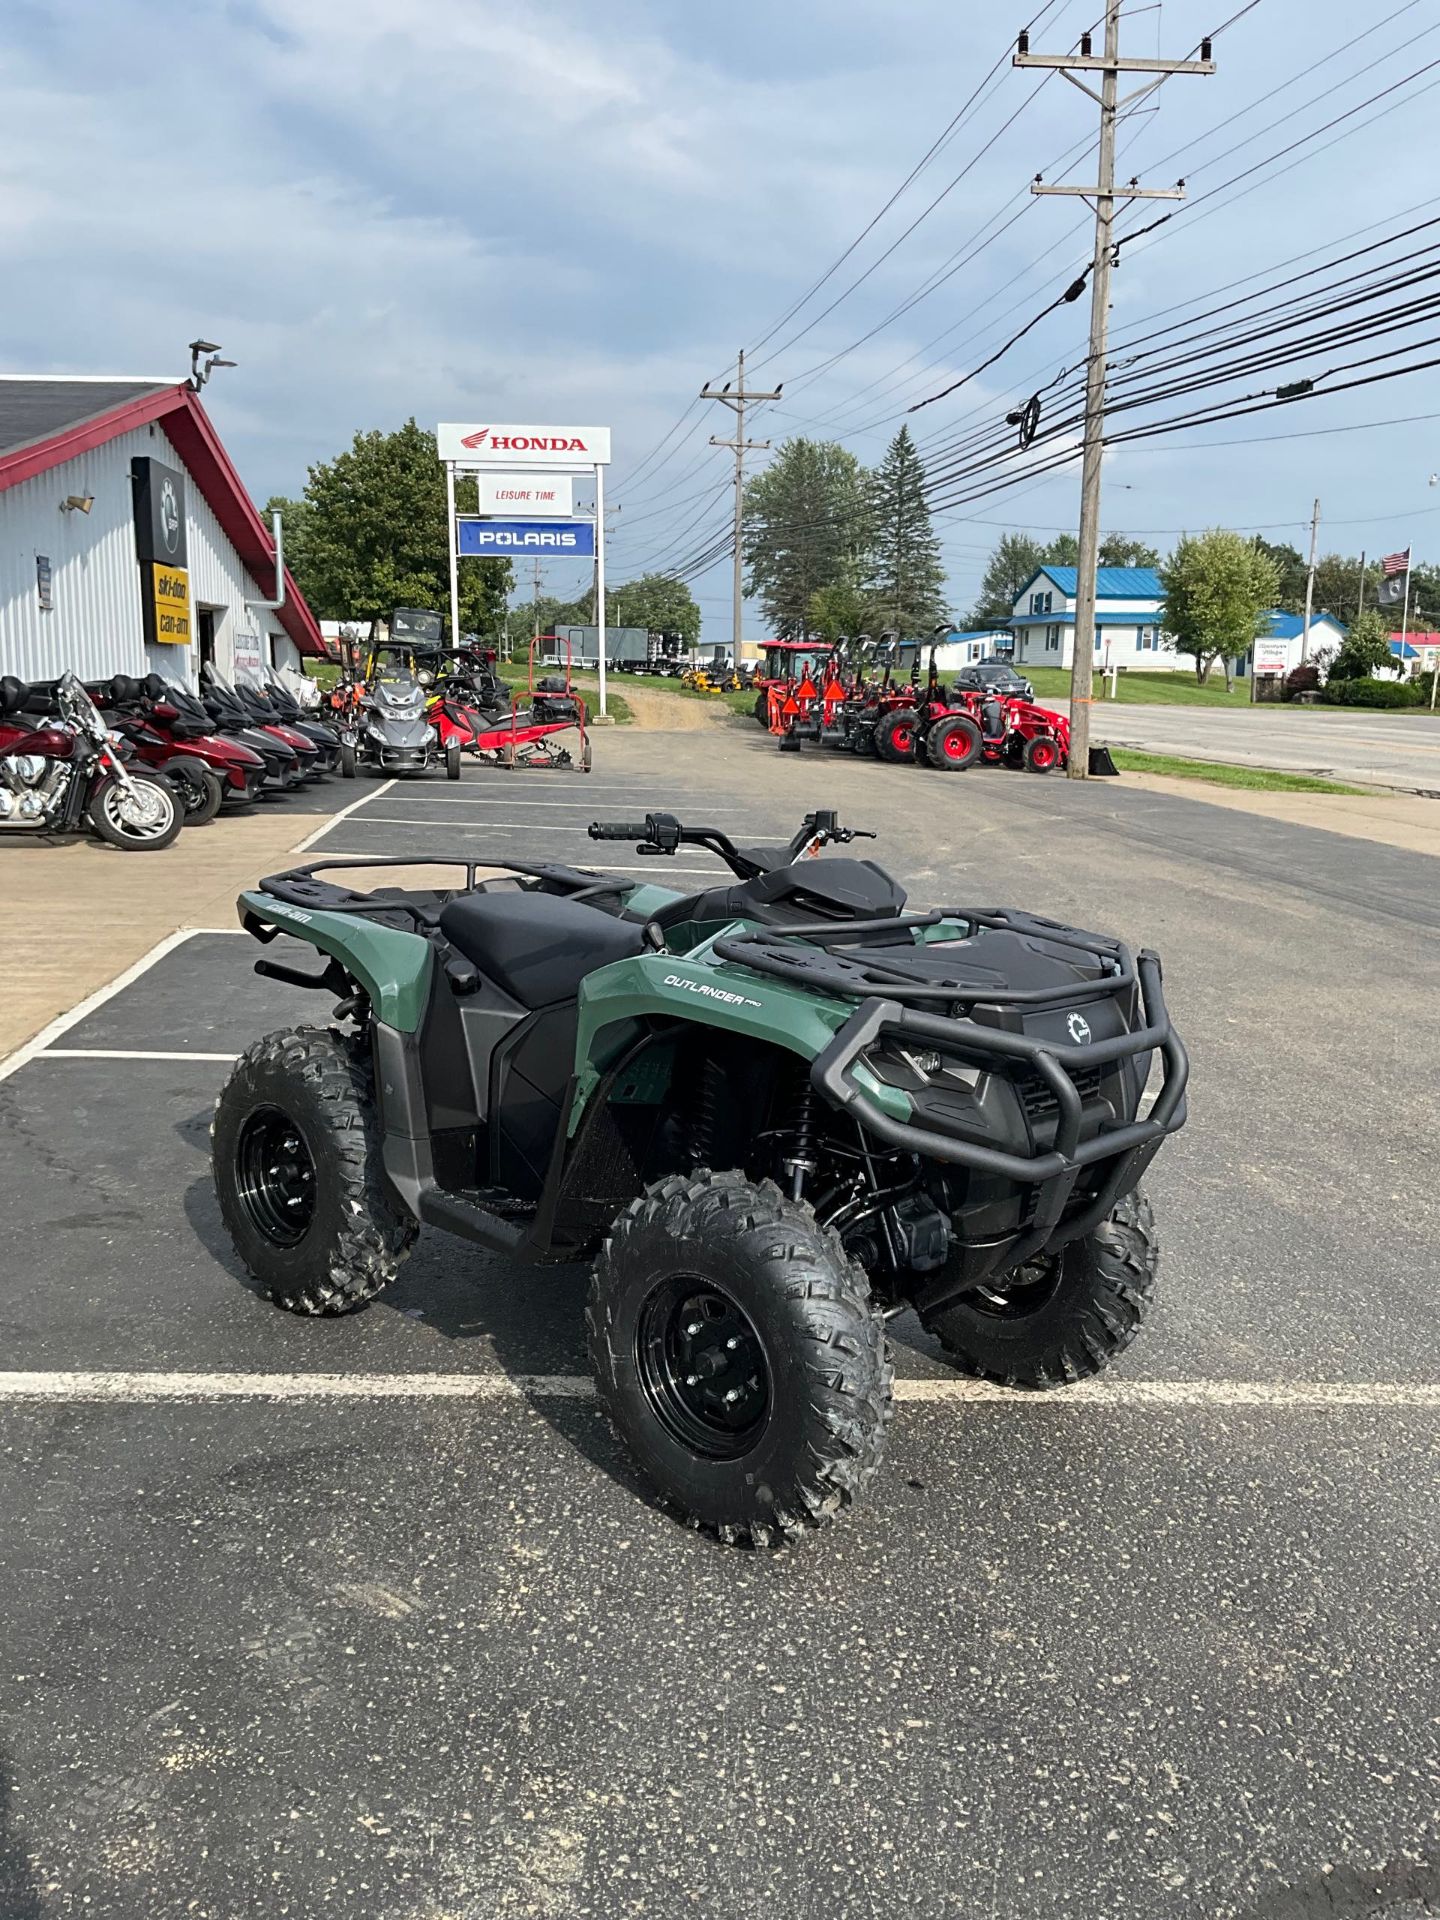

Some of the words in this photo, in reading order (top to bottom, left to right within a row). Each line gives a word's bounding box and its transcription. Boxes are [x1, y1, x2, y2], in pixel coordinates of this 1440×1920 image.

[490, 436, 588, 451] HONDA
[495, 490, 532, 500] LEISURE
[535, 491, 556, 501] TIME
[479, 531, 577, 546] POLARIS
[158, 574, 186, 600] ski-doo
[160, 614, 188, 635] can-am
[265, 903, 313, 923] can-am
[663, 974, 745, 1005] OUTLANDER
[744, 999, 762, 1007] PRO
